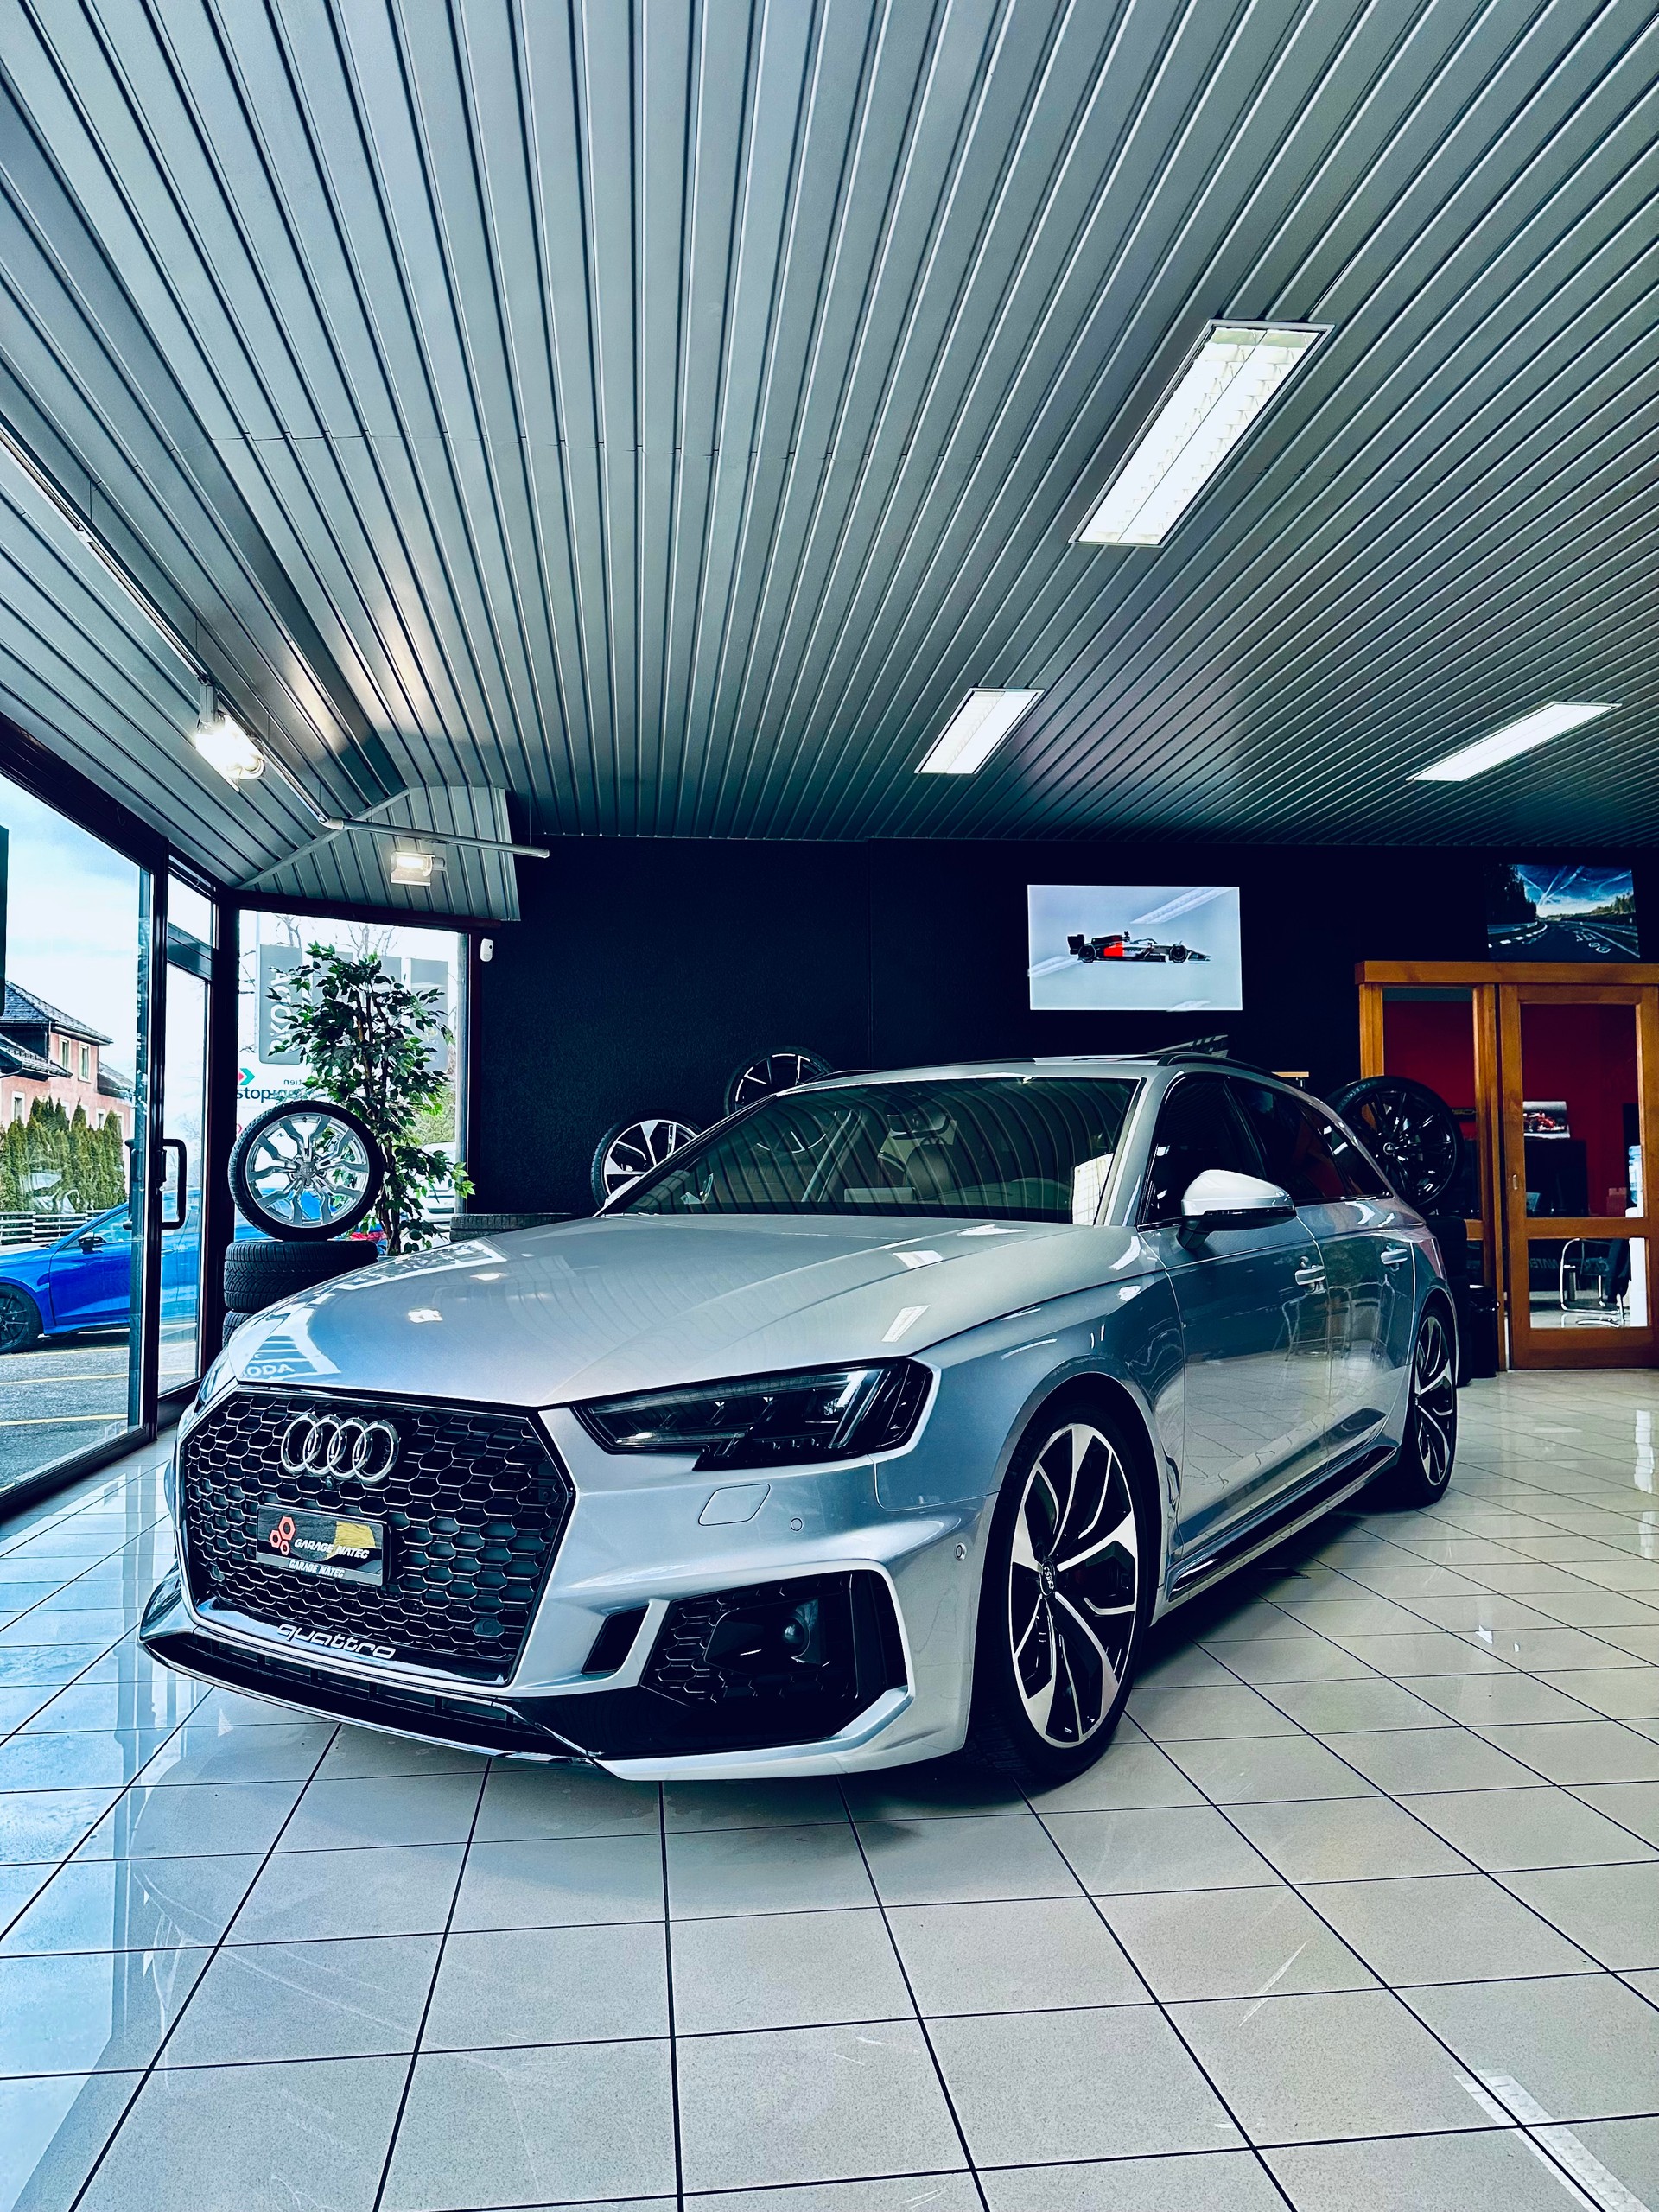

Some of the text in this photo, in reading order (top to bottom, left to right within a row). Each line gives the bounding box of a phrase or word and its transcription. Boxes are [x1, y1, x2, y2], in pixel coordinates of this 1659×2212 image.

[294, 1538, 370, 1560] GARAGE NATEC
[288, 1560, 346, 1579] GARAGE NATEC
[276, 1623, 397, 1660] quattro
